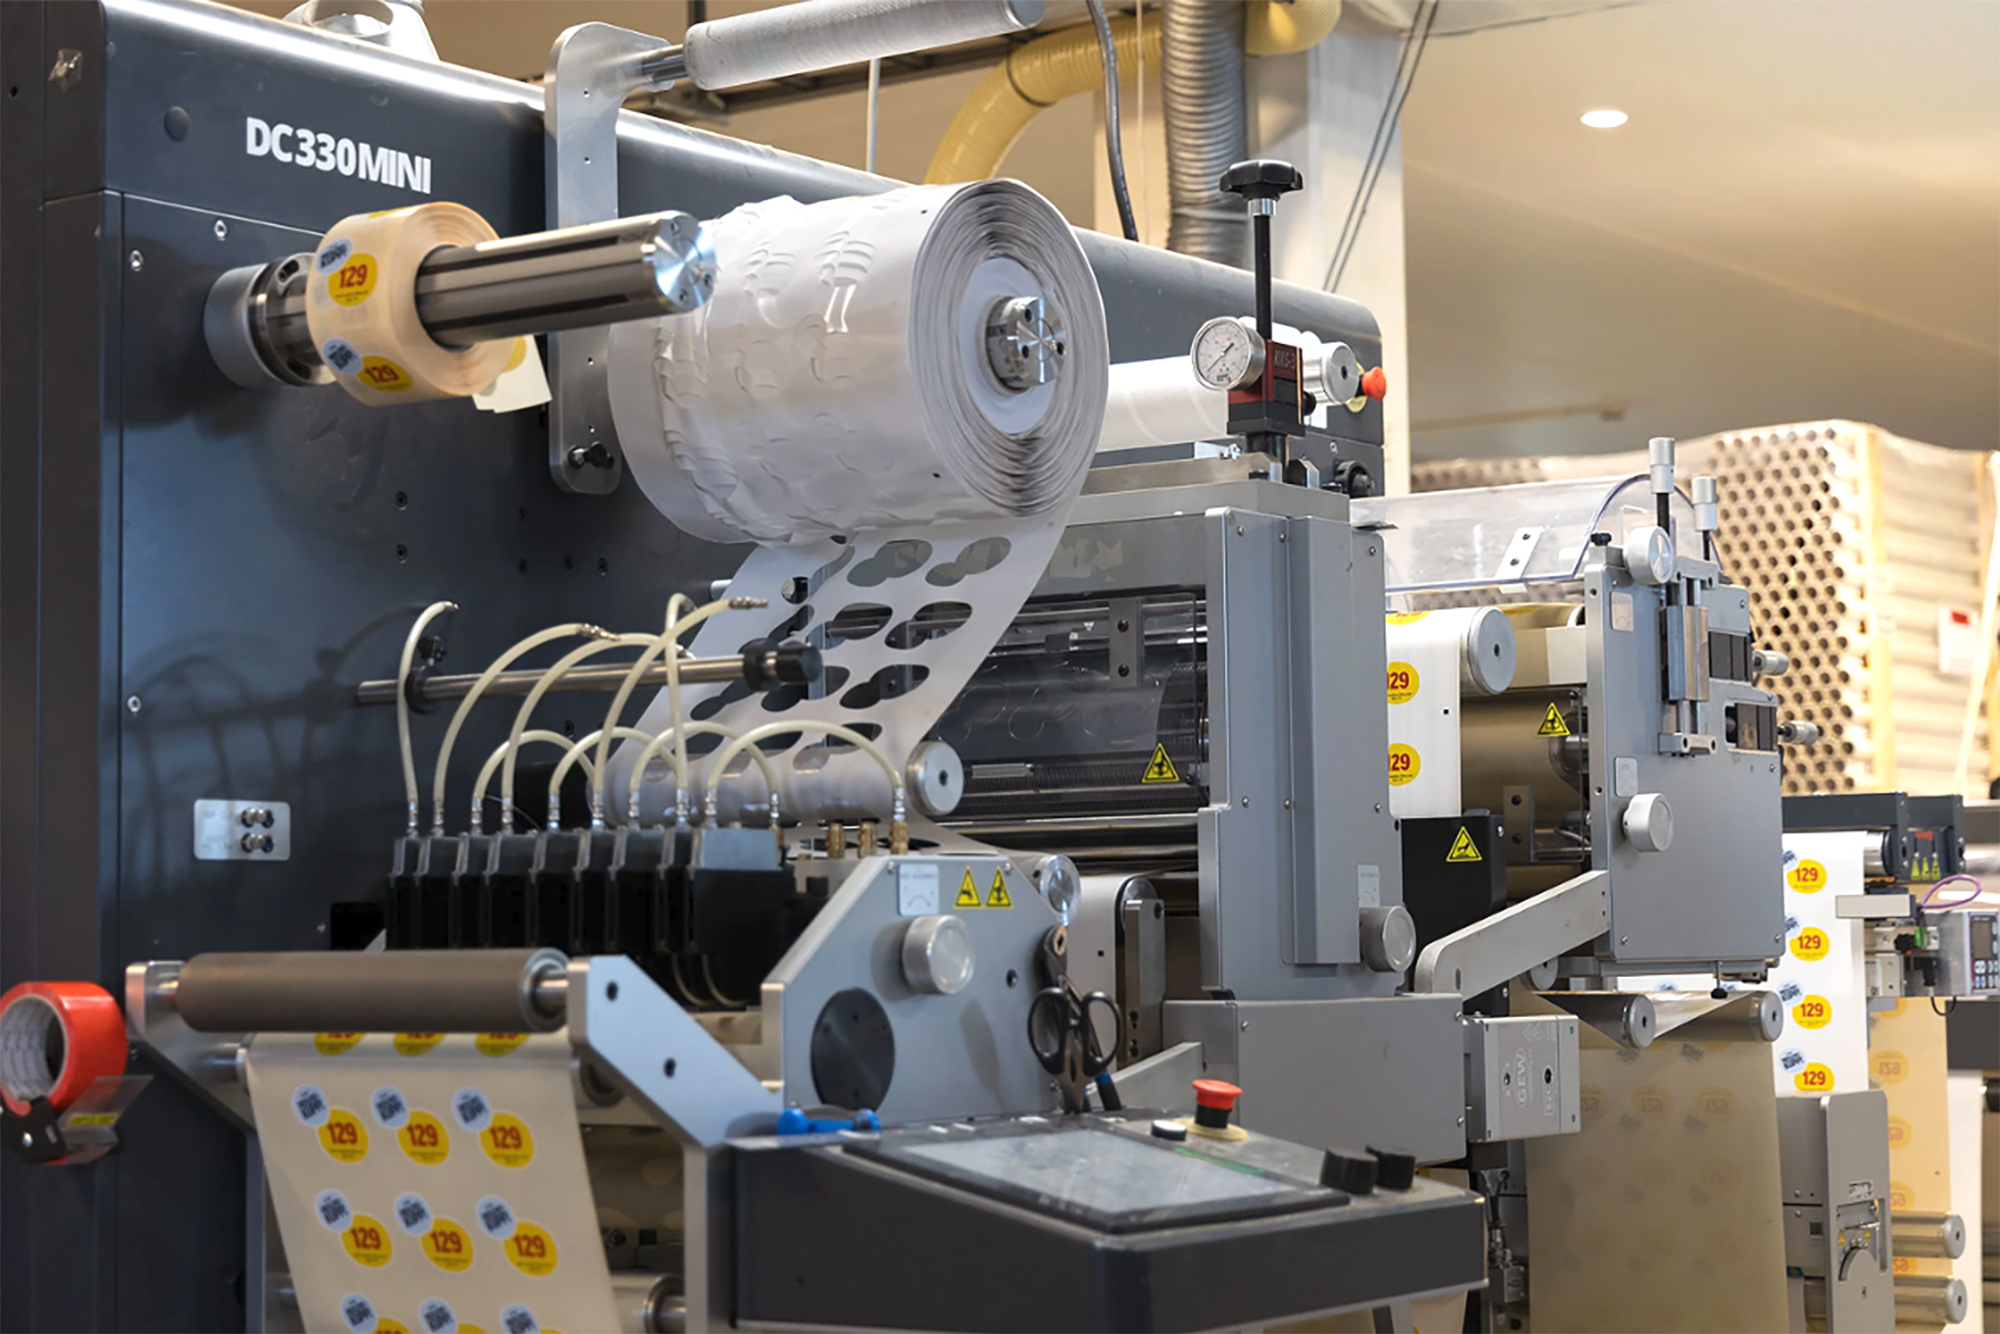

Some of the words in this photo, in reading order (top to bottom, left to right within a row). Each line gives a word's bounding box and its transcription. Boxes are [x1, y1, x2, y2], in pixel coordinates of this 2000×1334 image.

[246, 117, 432, 194] DC330MINI
[339, 264, 368, 288] 129
[364, 365, 399, 383] 129
[1795, 867, 1819, 882] 129
[1798, 935, 1822, 950] 129
[1801, 1002, 1825, 1017] 129
[1803, 1070, 1827, 1086] 129
[327, 1122, 358, 1145] 129
[407, 1124, 438, 1147] 129
[489, 1126, 522, 1150] 129
[351, 1227, 381, 1249] 129
[430, 1231, 462, 1253] 129
[513, 1235, 546, 1258] 129
